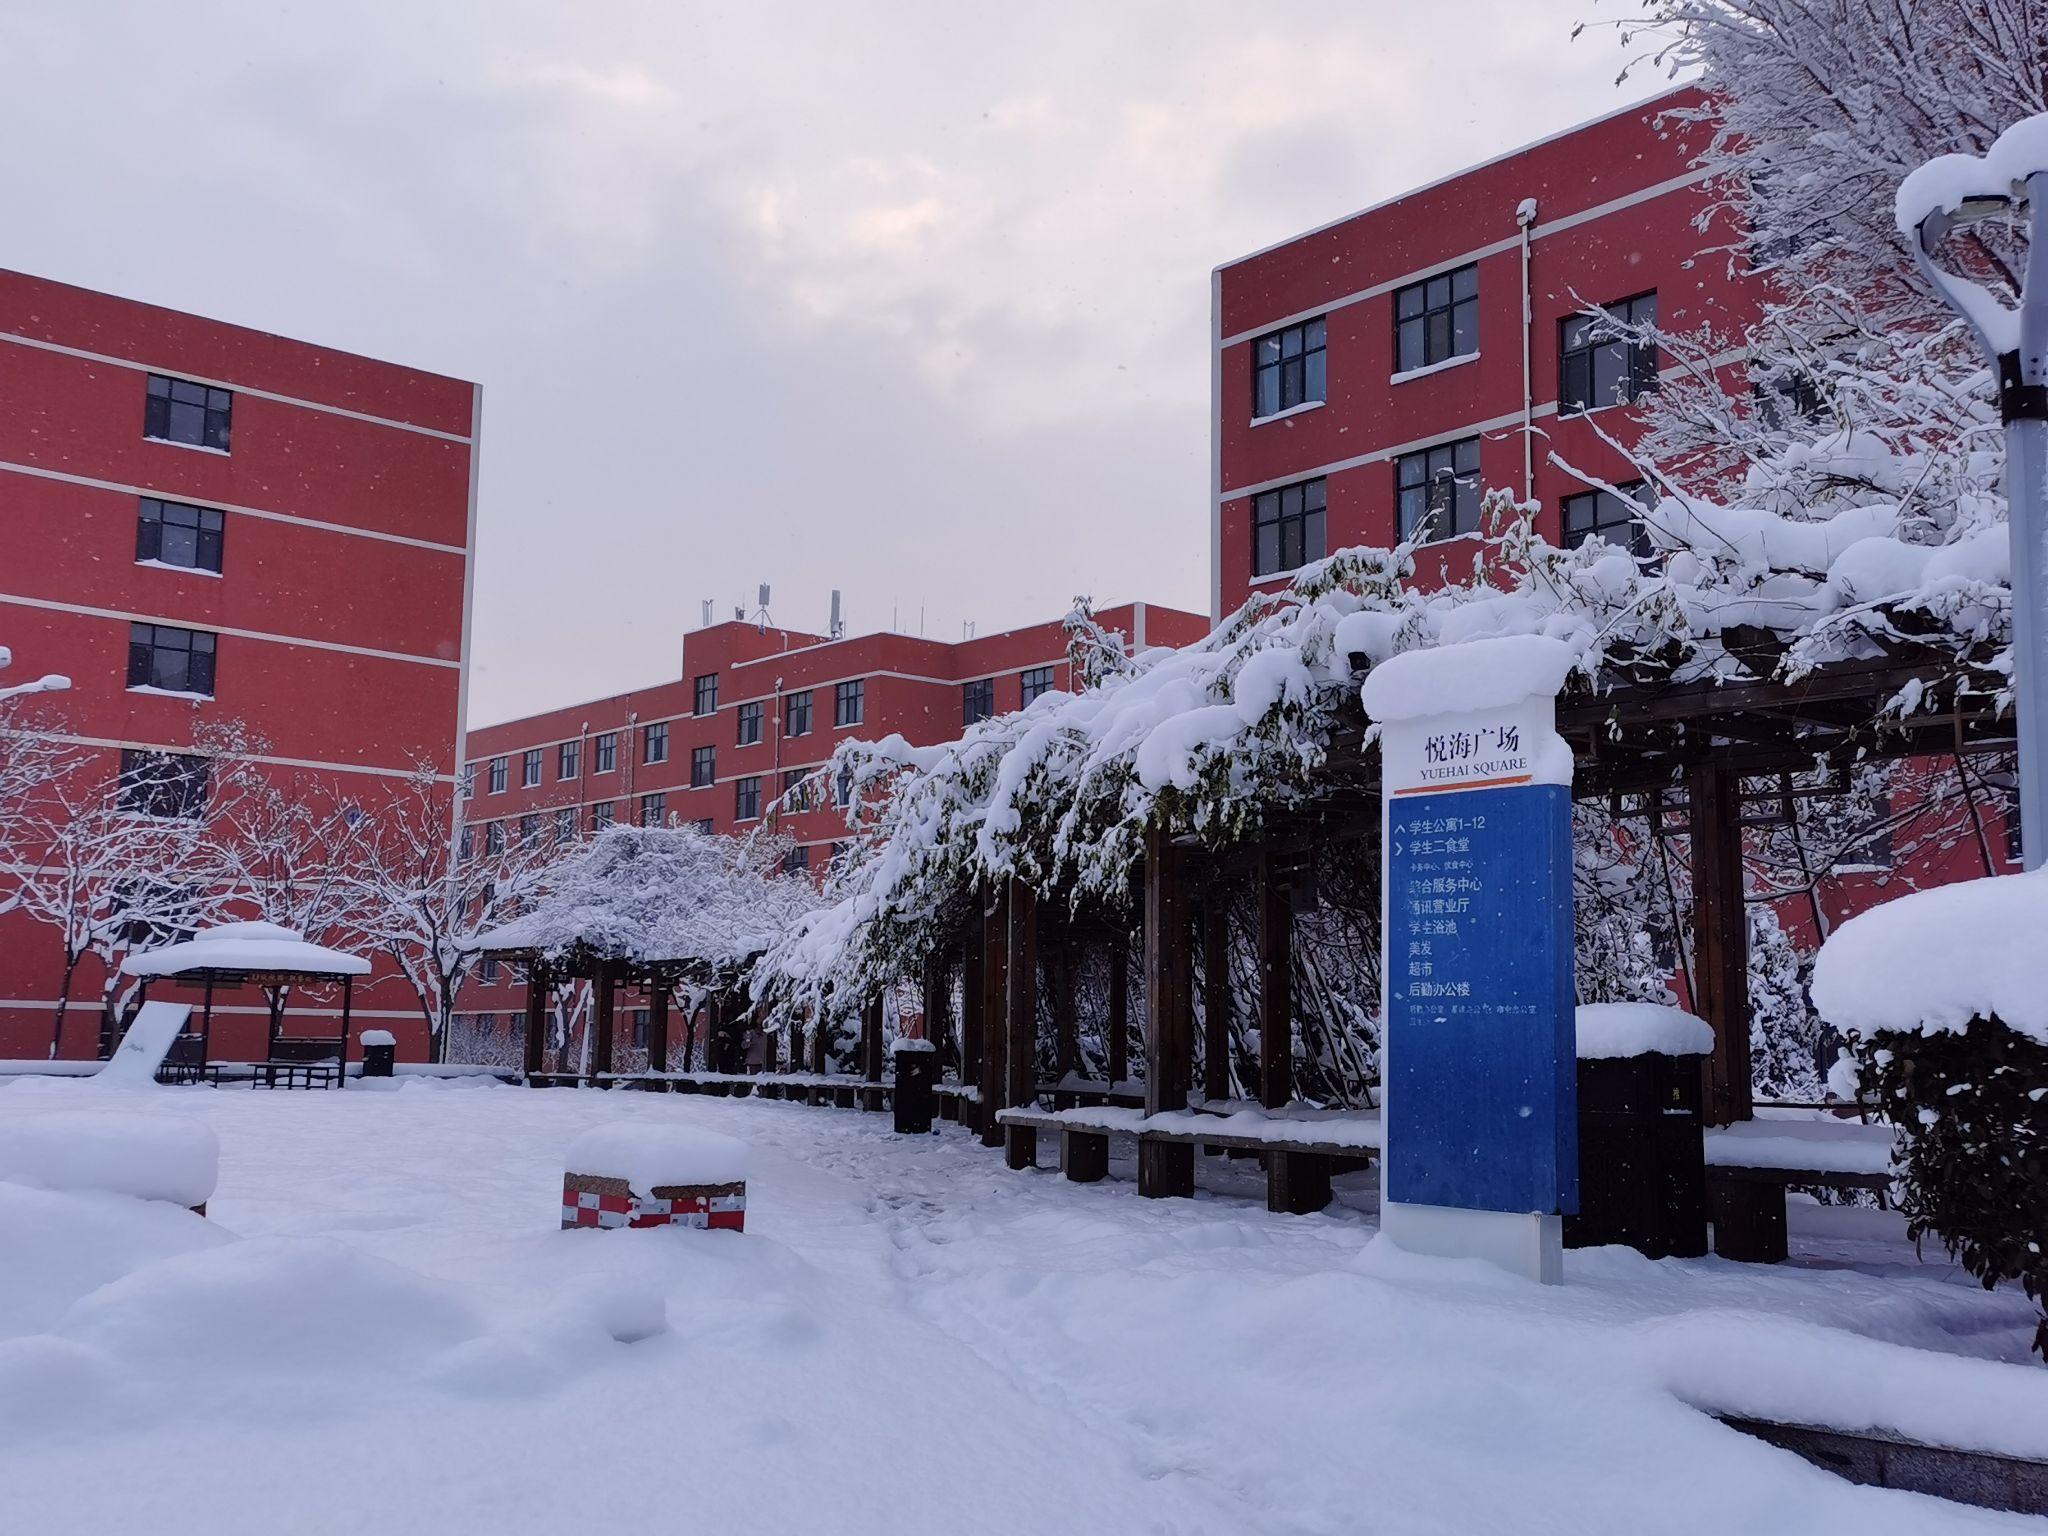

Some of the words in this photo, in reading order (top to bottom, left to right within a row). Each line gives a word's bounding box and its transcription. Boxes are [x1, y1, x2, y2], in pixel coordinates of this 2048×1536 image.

[1425, 726, 1519, 763] 悦海广场
[1420, 765, 1469, 780] YUEHAI
[1473, 758, 1528, 775] SQUARE
[1409, 837, 1470, 855] 学生二食堂
[1409, 919, 1457, 936] 学生浴池
[1409, 940, 1433, 957] 美发
[1409, 961, 1433, 977] 超市
[1409, 981, 1471, 997] 后勤办公楼
